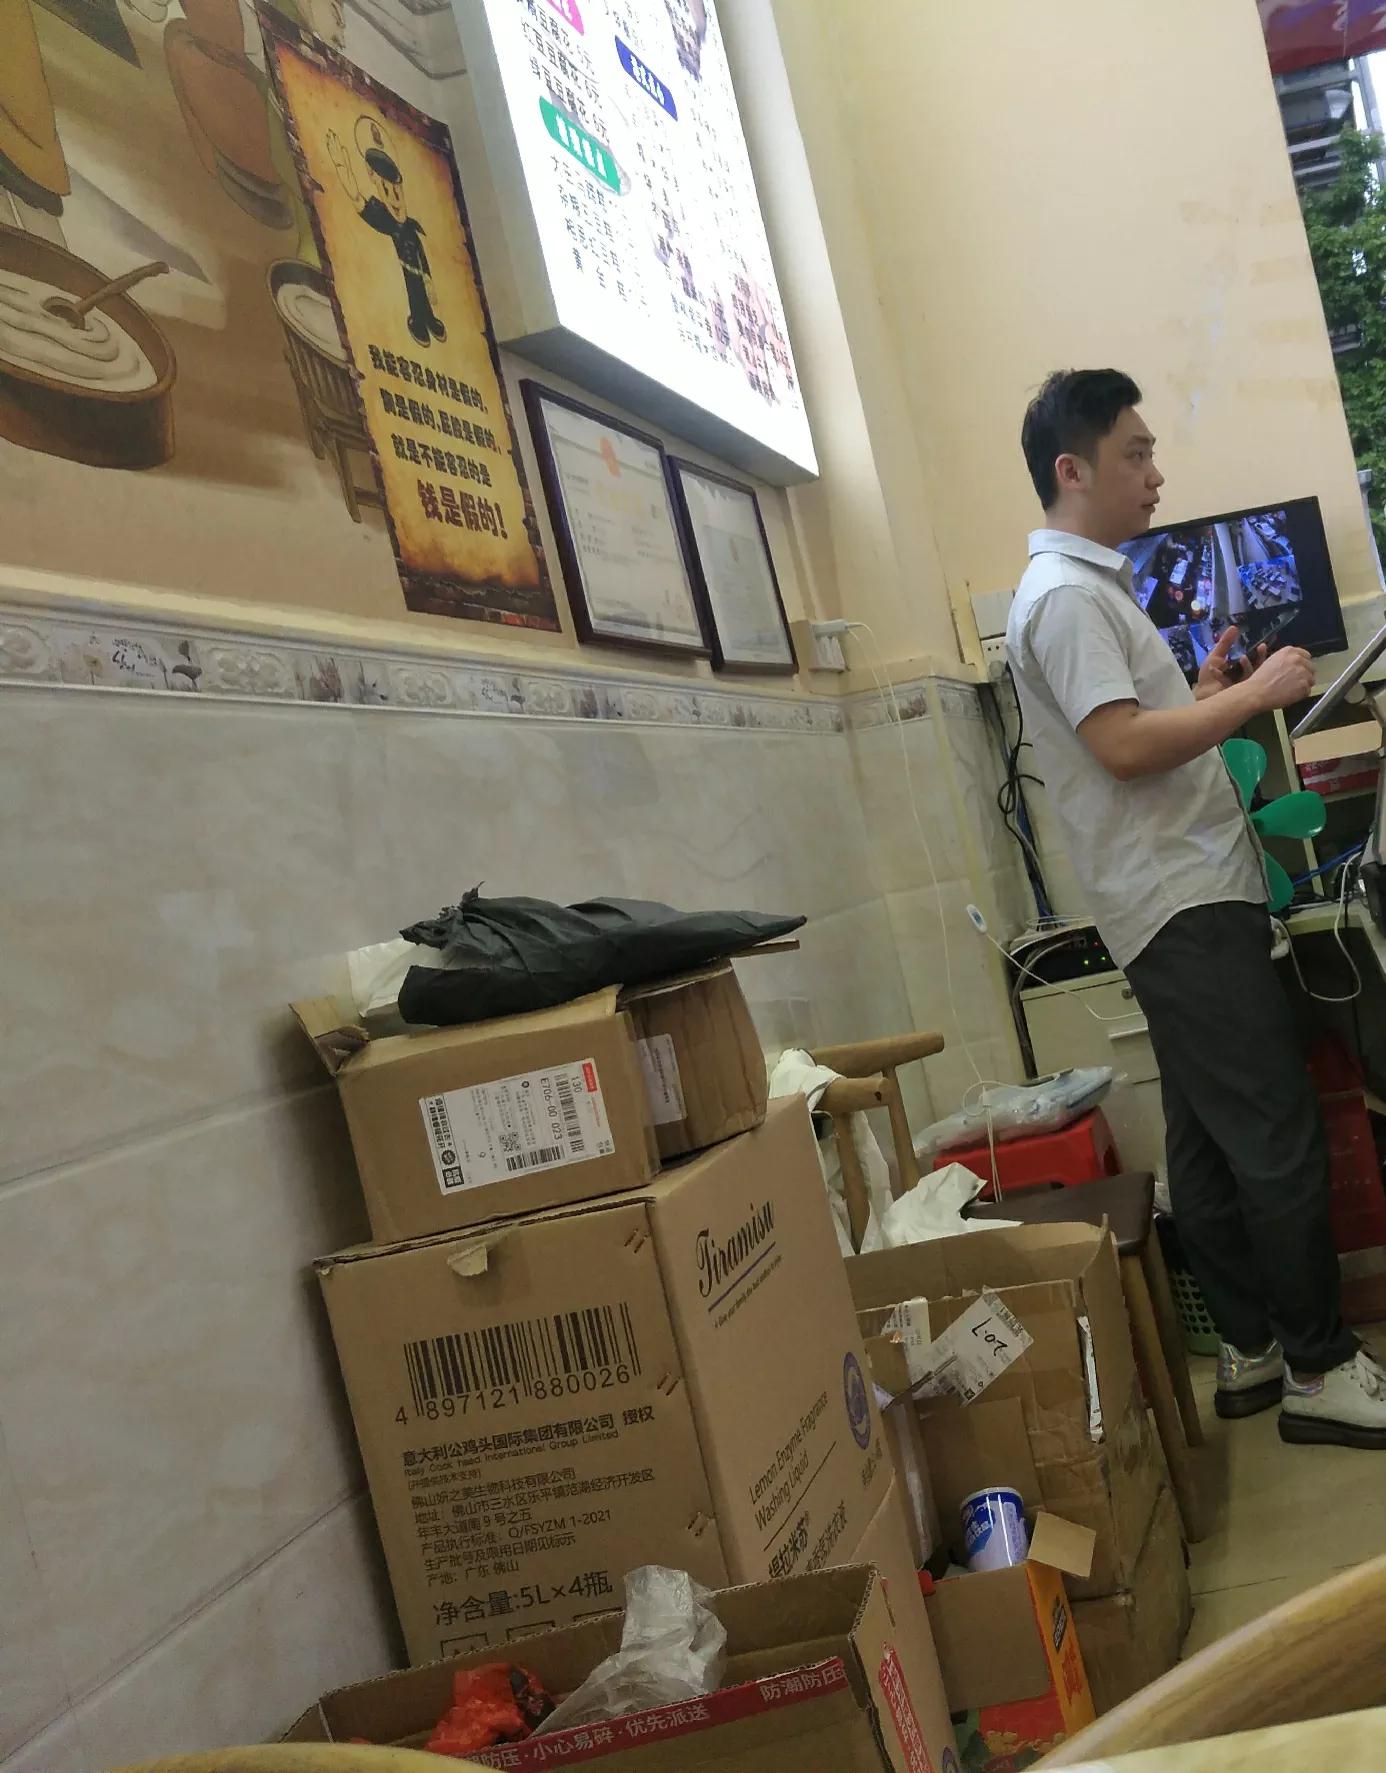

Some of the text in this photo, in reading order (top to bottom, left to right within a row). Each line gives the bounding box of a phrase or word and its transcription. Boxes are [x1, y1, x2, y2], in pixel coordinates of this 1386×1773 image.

[696, 1201, 775, 1298] Tiramisu
[395, 1364, 630, 1425] 4 897121 880026
[403, 1406, 655, 1467] 意大利公鸡头国际集团有限公司 授权
[749, 1463, 778, 1504] Lemon
[775, 1429, 802, 1471] Enzyme
[754, 1450, 809, 1531] Washing Liquid
[760, 1663, 847, 1702] 防潮防压
